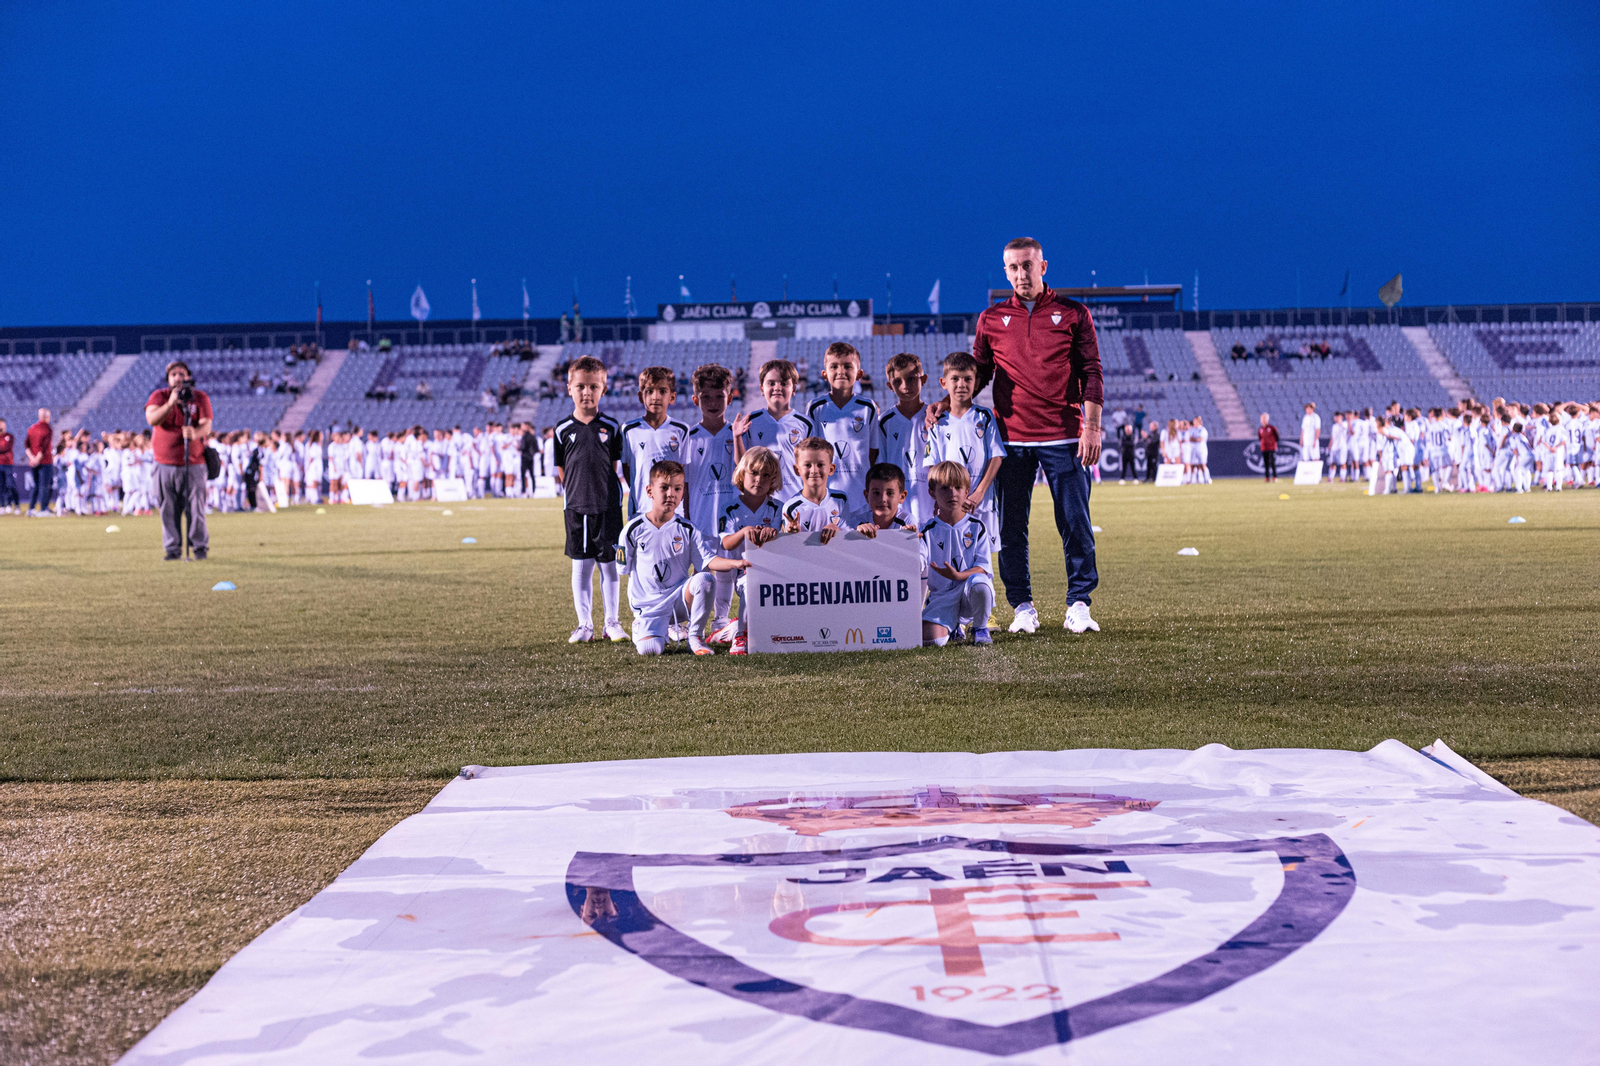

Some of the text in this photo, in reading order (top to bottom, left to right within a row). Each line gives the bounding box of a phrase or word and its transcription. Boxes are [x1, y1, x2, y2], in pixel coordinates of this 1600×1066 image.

[712, 305, 747, 318] CLIMA
[807, 303, 842, 316] CLIMA
[1569, 429, 1581, 444] 19
[759, 575, 909, 607] PREBENJAMÍN B
[909, 983, 1064, 1003] 1922
